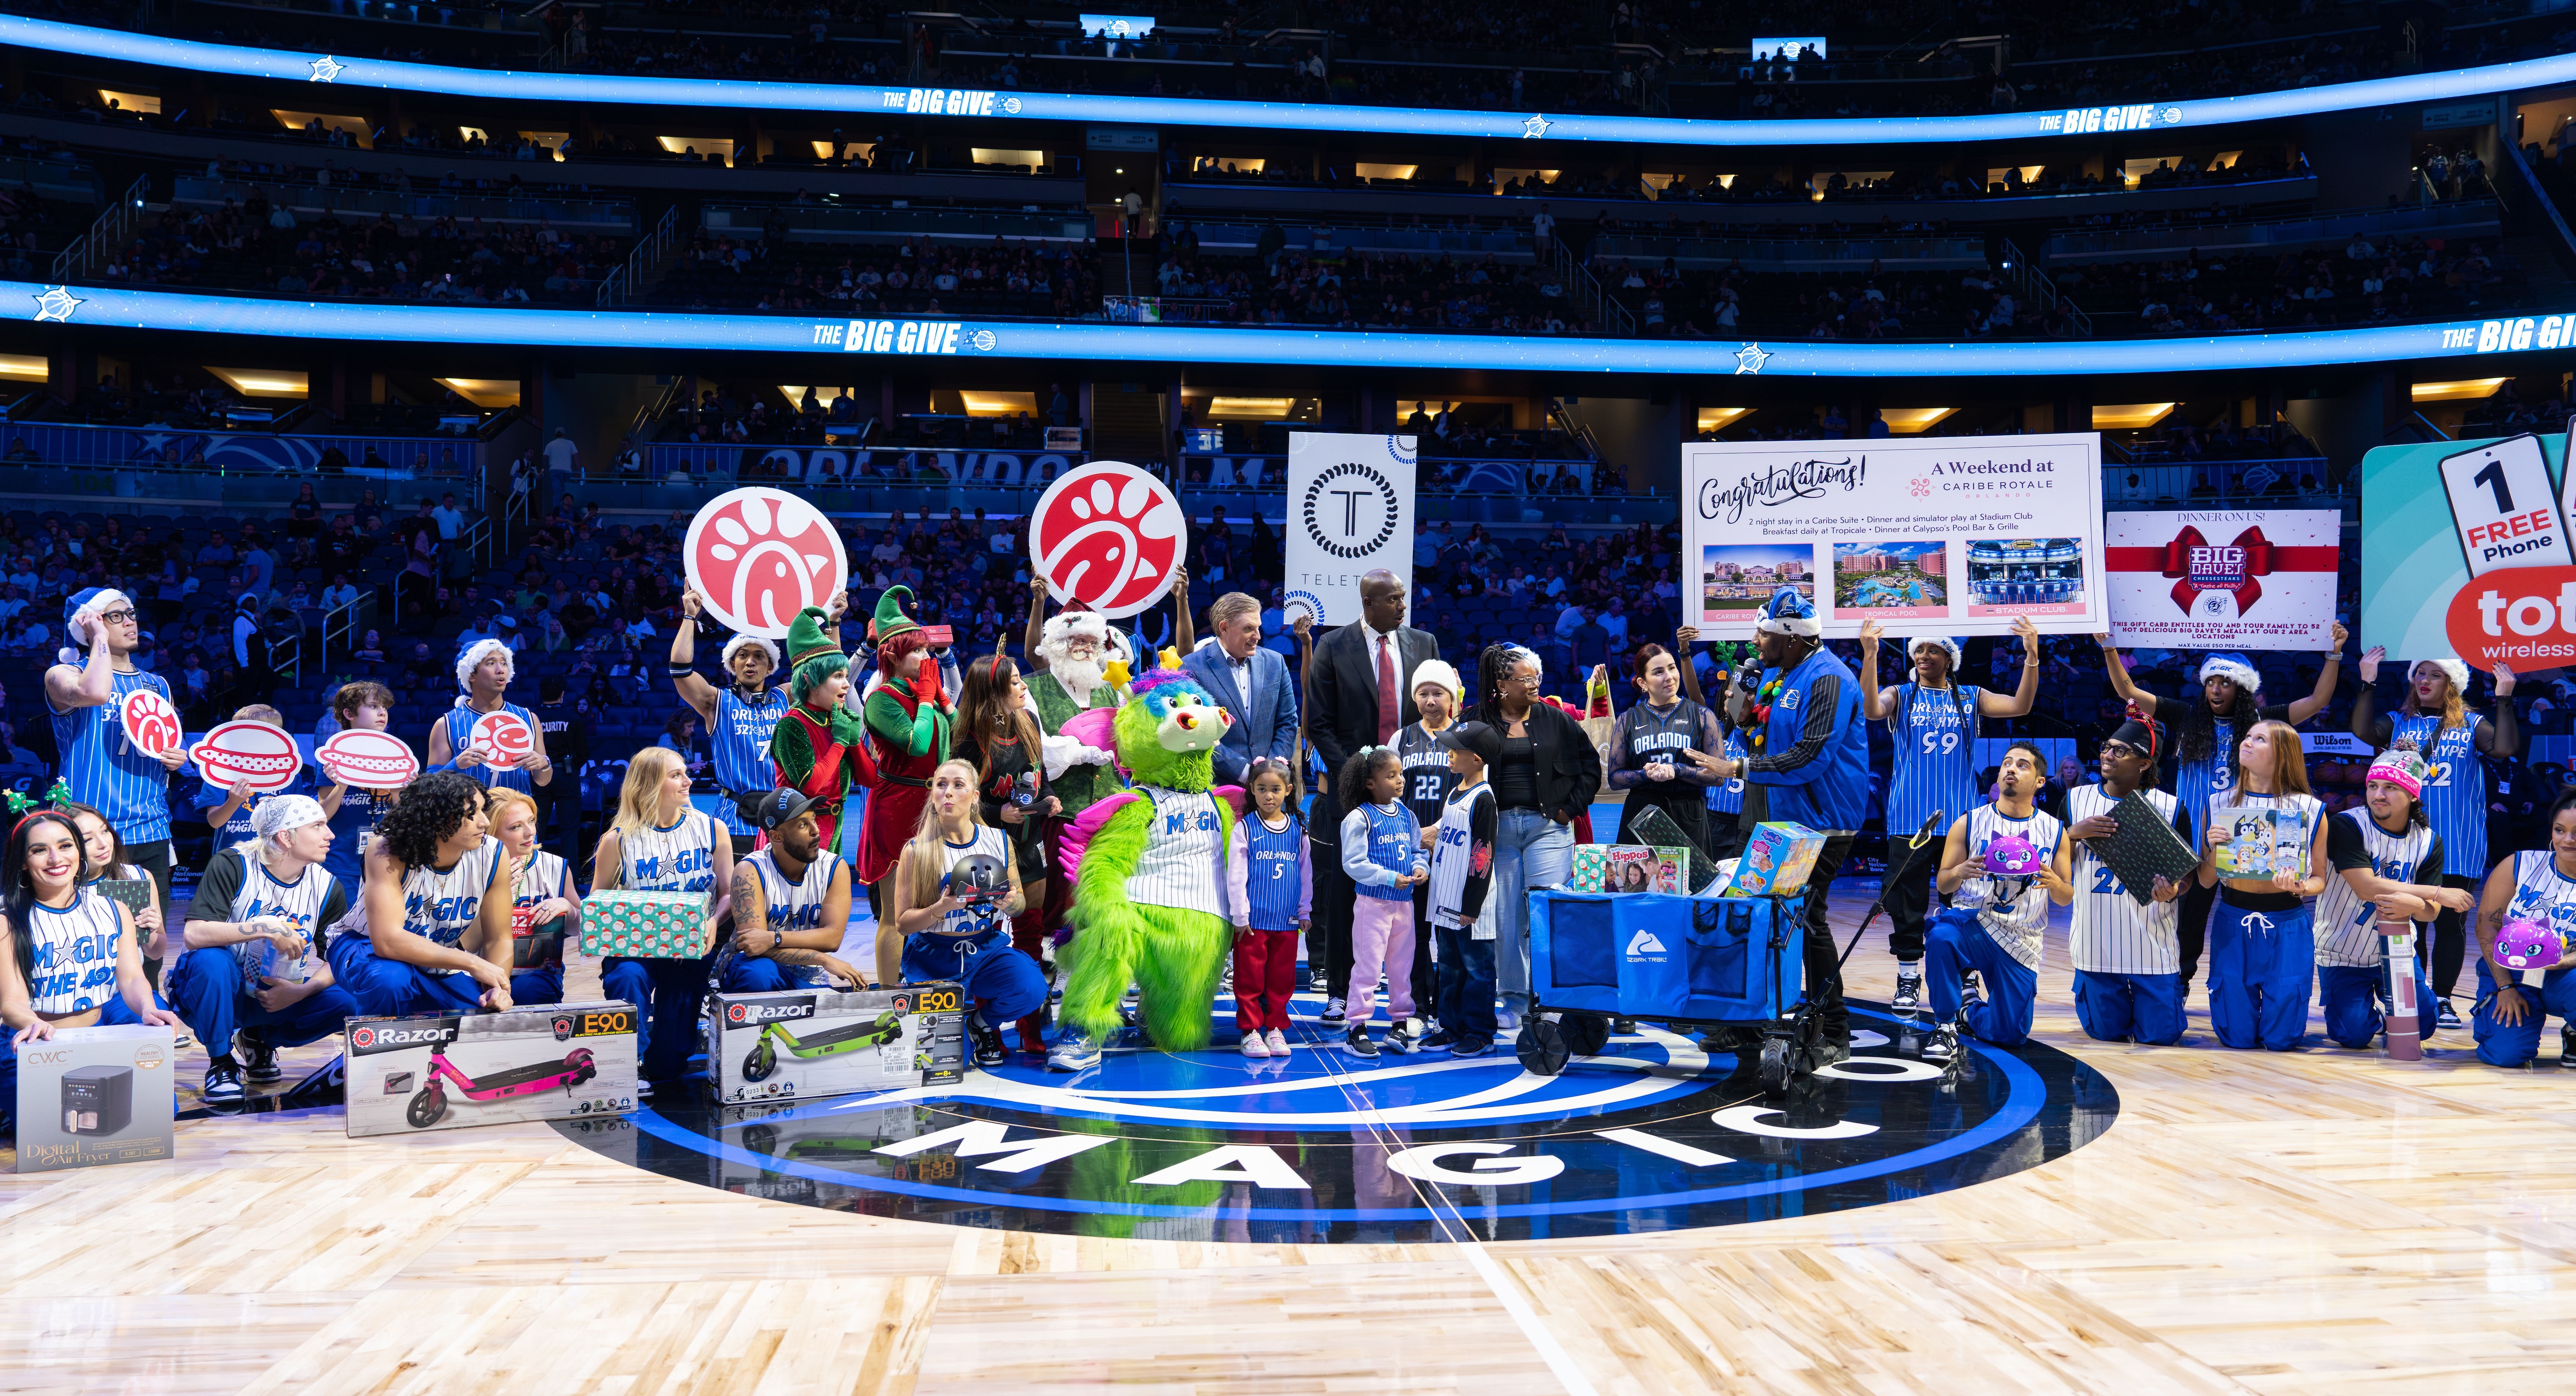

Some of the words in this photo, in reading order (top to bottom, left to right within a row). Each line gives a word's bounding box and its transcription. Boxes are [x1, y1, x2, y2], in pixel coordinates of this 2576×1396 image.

[884, 92, 905, 108] THE
[907, 89, 943, 114] BIG
[946, 90, 995, 116] GIVE
[2039, 115, 2062, 131] THE
[2063, 108, 2103, 133] BIG
[2104, 105, 2155, 132] GIVE
[814, 325, 842, 345] THE
[844, 321, 894, 351] BIG
[897, 322, 962, 355] GIVE
[2442, 328, 2476, 348] THE
[2477, 318, 2534, 352] BIG
[2538, 314, 2576, 348] GI
[1931, 463, 1944, 475] A
[1948, 459, 2031, 474] Weekend
[2037, 461, 2054, 472] at
[1699, 455, 1866, 524] Congratulations!
[2473, 460, 2515, 514] 1
[2178, 513, 2222, 522] DINNER
[2226, 513, 2243, 521] ON
[2467, 509, 2552, 548] FREE
[2192, 547, 2244, 564] BIG
[2483, 536, 2552, 562] Phone
[2191, 563, 2243, 575] DAVE'S
[1301, 574, 1361, 586] TELET
[2482, 641, 2574, 658] wireless
[541, 721, 569, 732] CURITY
[756, 740, 772, 762] 7
[1634, 732, 1691, 755] ORLANDO
[1922, 731, 1959, 755] 99
[2313, 735, 2351, 746] Wilson
[1402, 751, 1450, 770] ORLAND
[1415, 775, 1442, 800] 22
[2212, 767, 2232, 789] 3
[2388, 773, 2418, 789] BRIGHT
[1763, 830, 1774, 840] Peppa
[1773, 835, 1782, 844] Pig
[1397, 844, 1406, 861] 5
[1272, 863, 1284, 879] 5
[31, 972, 78, 998] THE
[920, 992, 956, 1011] E90
[585, 1013, 627, 1033] E90
[27, 1140, 79, 1165] Digital
[55, 1154, 73, 1165] Air
[78, 1151, 111, 1164] Fryer
[870, 1106, 1879, 1189] MAGIC
